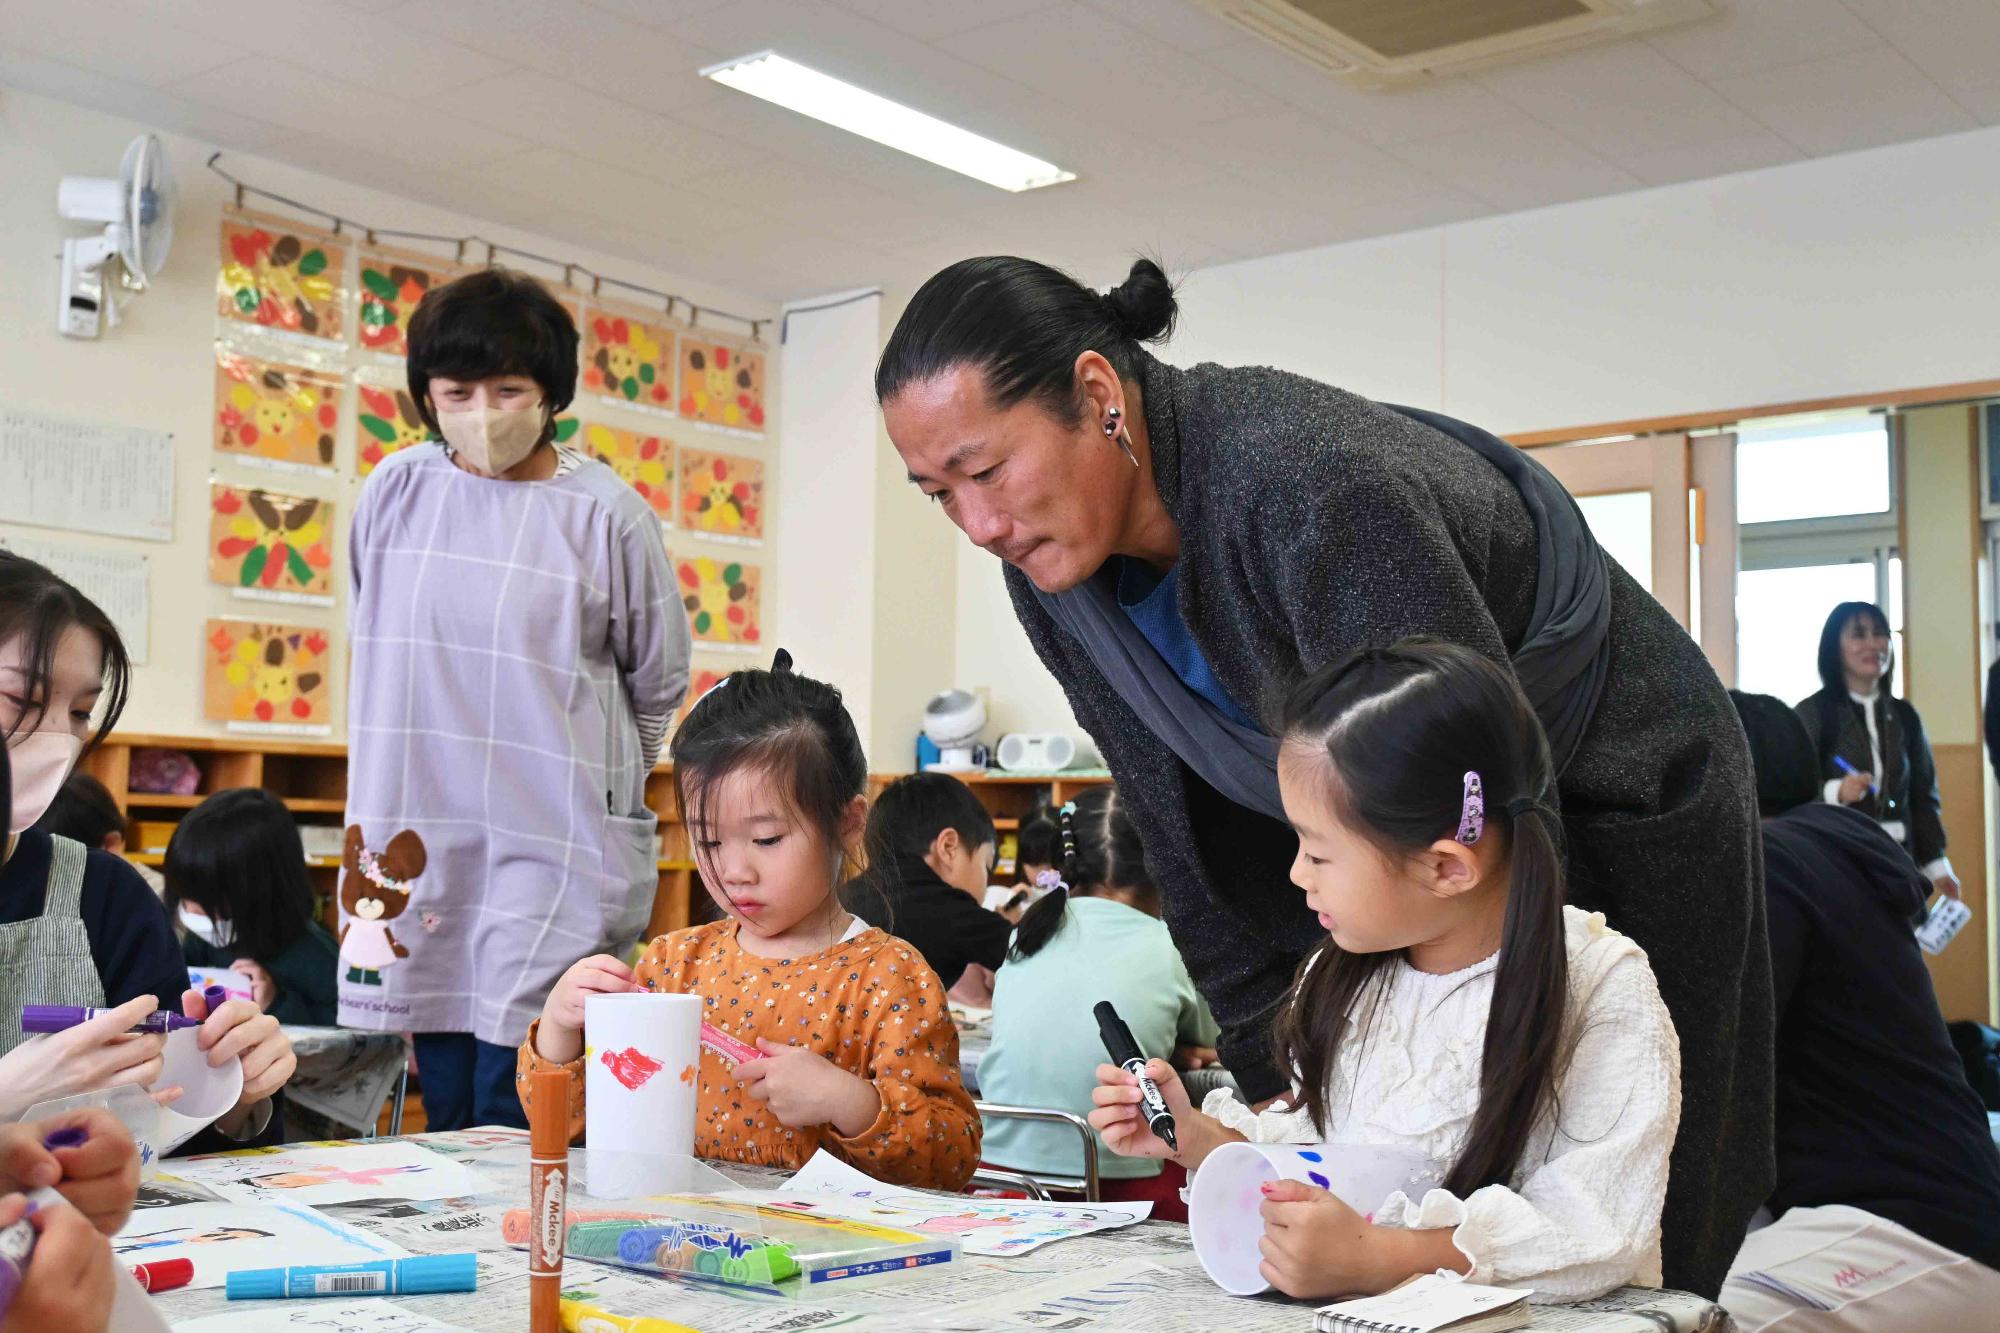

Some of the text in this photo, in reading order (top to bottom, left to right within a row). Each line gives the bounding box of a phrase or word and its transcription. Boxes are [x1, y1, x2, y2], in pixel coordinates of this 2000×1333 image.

[372, 1001, 410, 1015] school
[1141, 1078, 1158, 1100] Mckee
[548, 1200, 560, 1247] Mckee
